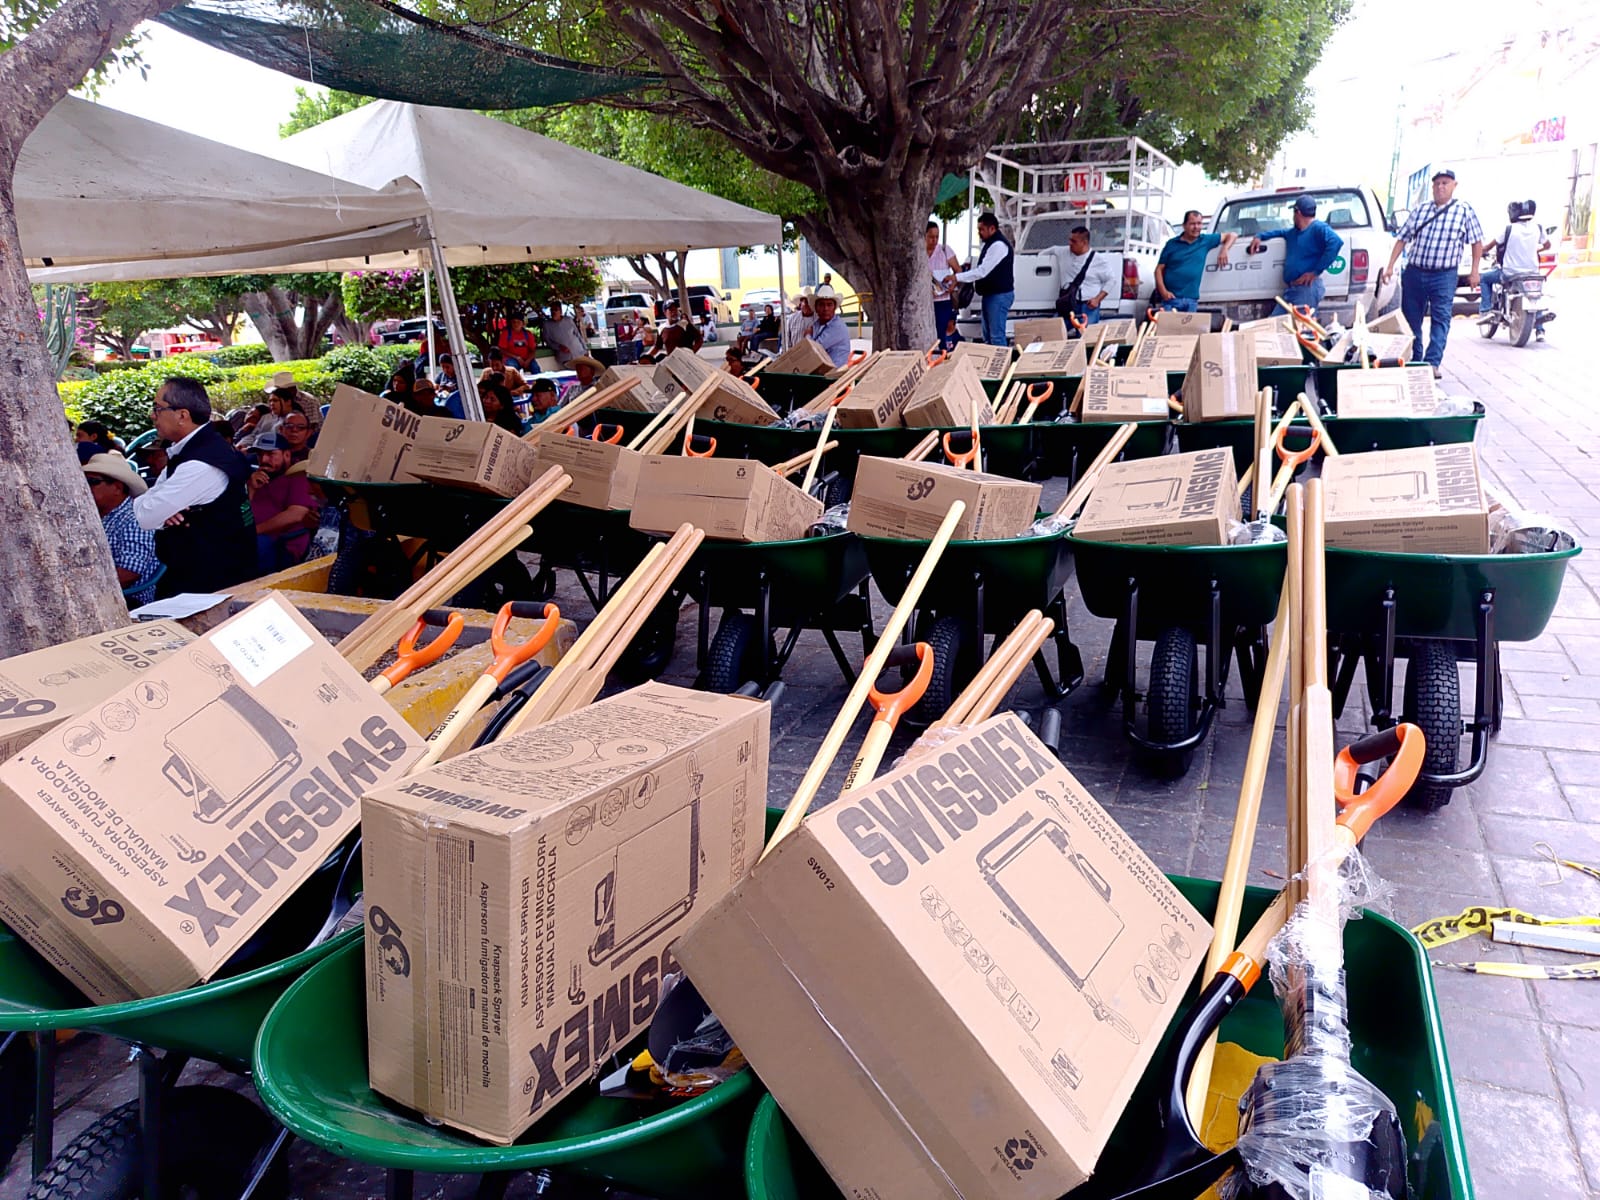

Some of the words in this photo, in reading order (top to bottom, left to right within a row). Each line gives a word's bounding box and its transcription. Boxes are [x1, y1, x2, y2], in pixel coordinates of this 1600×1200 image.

[1068, 172, 1100, 193] ALTO
[1206, 261, 1263, 273] ODGE
[877, 359, 925, 424] SWISSMEX
[483, 432, 504, 481] SWISSMEX
[1434, 446, 1481, 512] SWISSMEX
[1179, 451, 1226, 519] SWISSMEX
[30, 755, 106, 829] FUMIGADORA
[55, 759, 109, 811] MOCHILA
[844, 757, 864, 790] TRUPER
[36, 788, 81, 831] SPRAYER
[105, 808, 124, 826] DE
[398, 782, 527, 820] SWISSMEX
[836, 719, 1055, 886] SWISSMEX
[78, 827, 131, 878] KNAPSACK
[104, 825, 169, 888] ASPERSORA
[123, 823, 169, 870] MANUAL
[164, 714, 408, 948] SWISSMEX
[1057, 780, 1120, 850] ASPERSORA
[1121, 849, 1196, 932] FUMIGADORA
[1087, 800, 1136, 852] KNAPSACK
[1136, 853, 1177, 898] SPRAYER
[547, 845, 558, 920] MOCHILA
[807, 857, 836, 892] SW012
[1063, 794, 1108, 846] MANUAL
[1109, 845, 1128, 864] DE
[1126, 864, 1179, 923] MOCHILA
[479, 881, 489, 937] Aspersora
[521, 876, 531, 936] SPRAYER
[536, 833, 548, 938] FUMIGADORA
[546, 921, 556, 939] DE
[479, 937, 490, 995] fumigadora
[492, 944, 502, 996] Knapsack
[520, 938, 530, 1008] KNAPSACK
[535, 940, 545, 1030] ASPERSORA
[545, 941, 555, 1008] MANUAL
[480, 995, 489, 1033] manual
[491, 996, 502, 1036] Sprayer
[481, 1034, 489, 1048] de
[481, 1049, 491, 1088] mochila
[993, 1145, 1023, 1182] RECICLABLE
[1024, 1128, 1049, 1158] EMPAQUE
